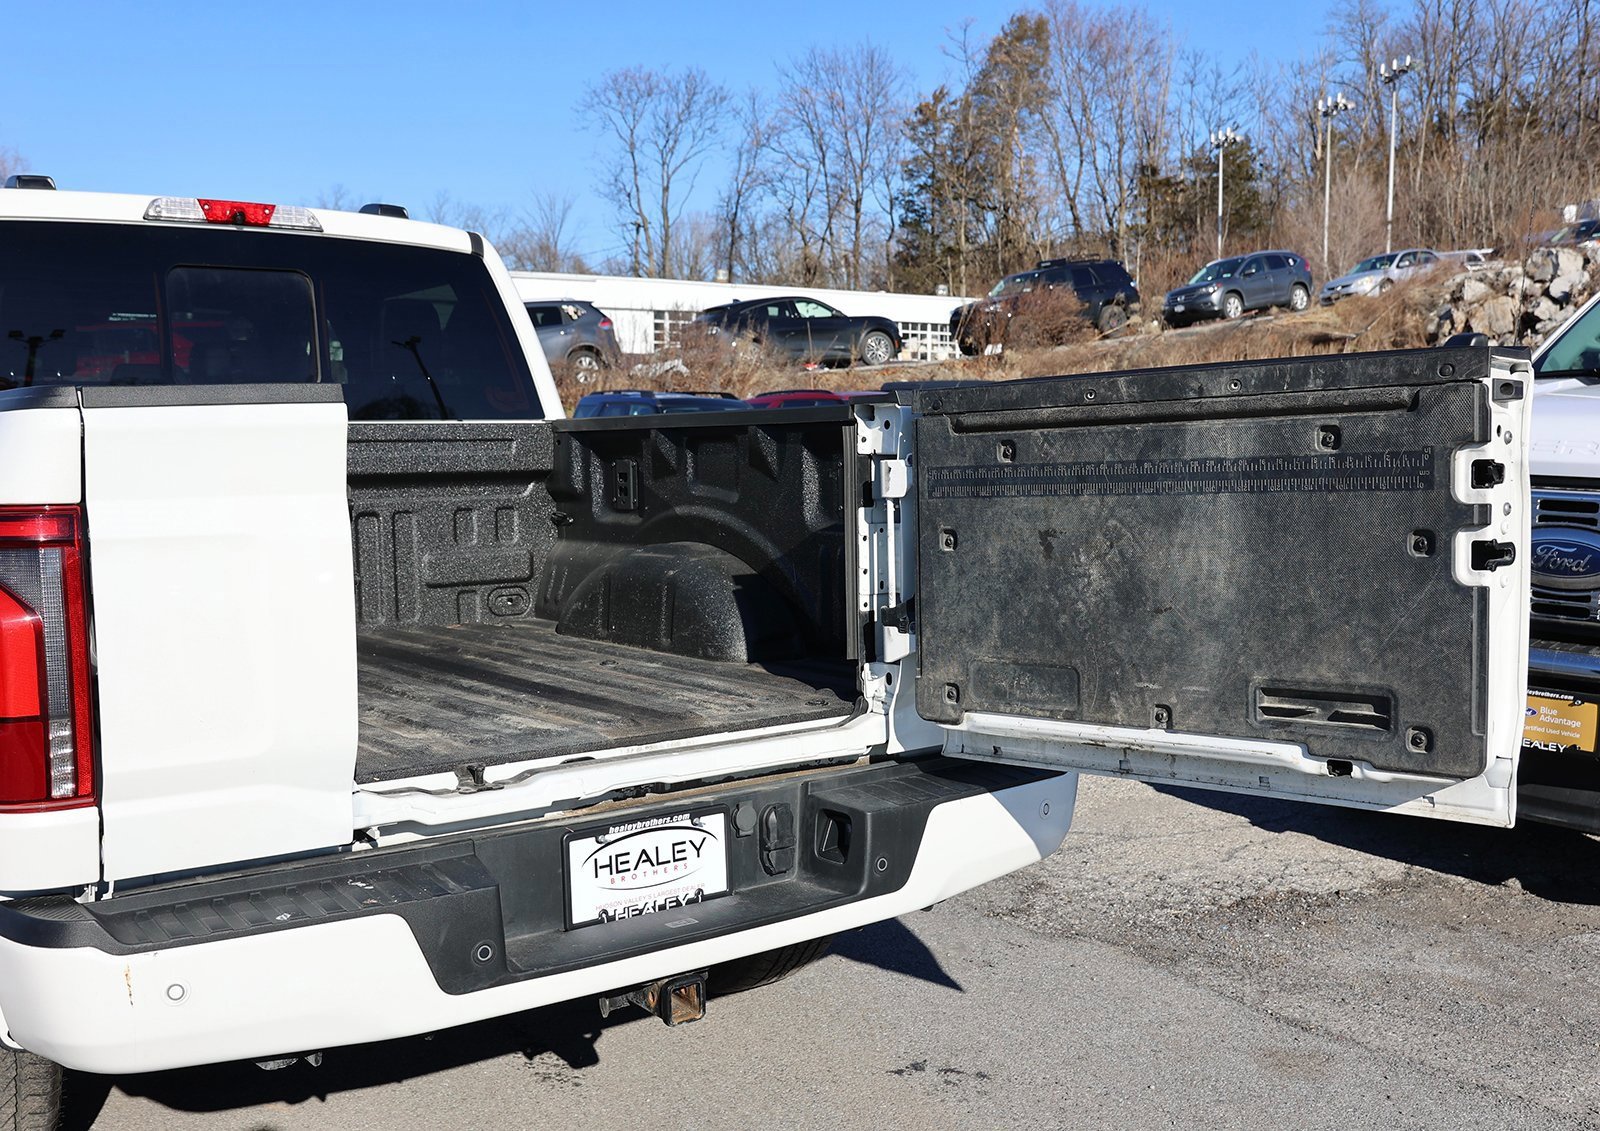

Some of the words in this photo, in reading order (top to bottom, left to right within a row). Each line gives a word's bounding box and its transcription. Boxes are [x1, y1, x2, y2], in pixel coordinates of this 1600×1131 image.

[1532, 544, 1593, 572] Ford
[1527, 690, 1574, 700] leybrothers.com
[1540, 706, 1558, 715] Blue
[1540, 714, 1582, 728] Advantage
[1545, 727, 1560, 735] Used
[1561, 730, 1581, 739] Vehicle
[1522, 738, 1567, 753] EALEY
[608, 813, 690, 834] healeybrothers.com
[594, 837, 707, 878] HEALEY
[610, 863, 689, 885] BROTHERS
[596, 900, 622, 911] HUDSON
[622, 894, 652, 905] VALLEY'S
[653, 888, 681, 900] LARGEST
[680, 883, 706, 894] DEALER
